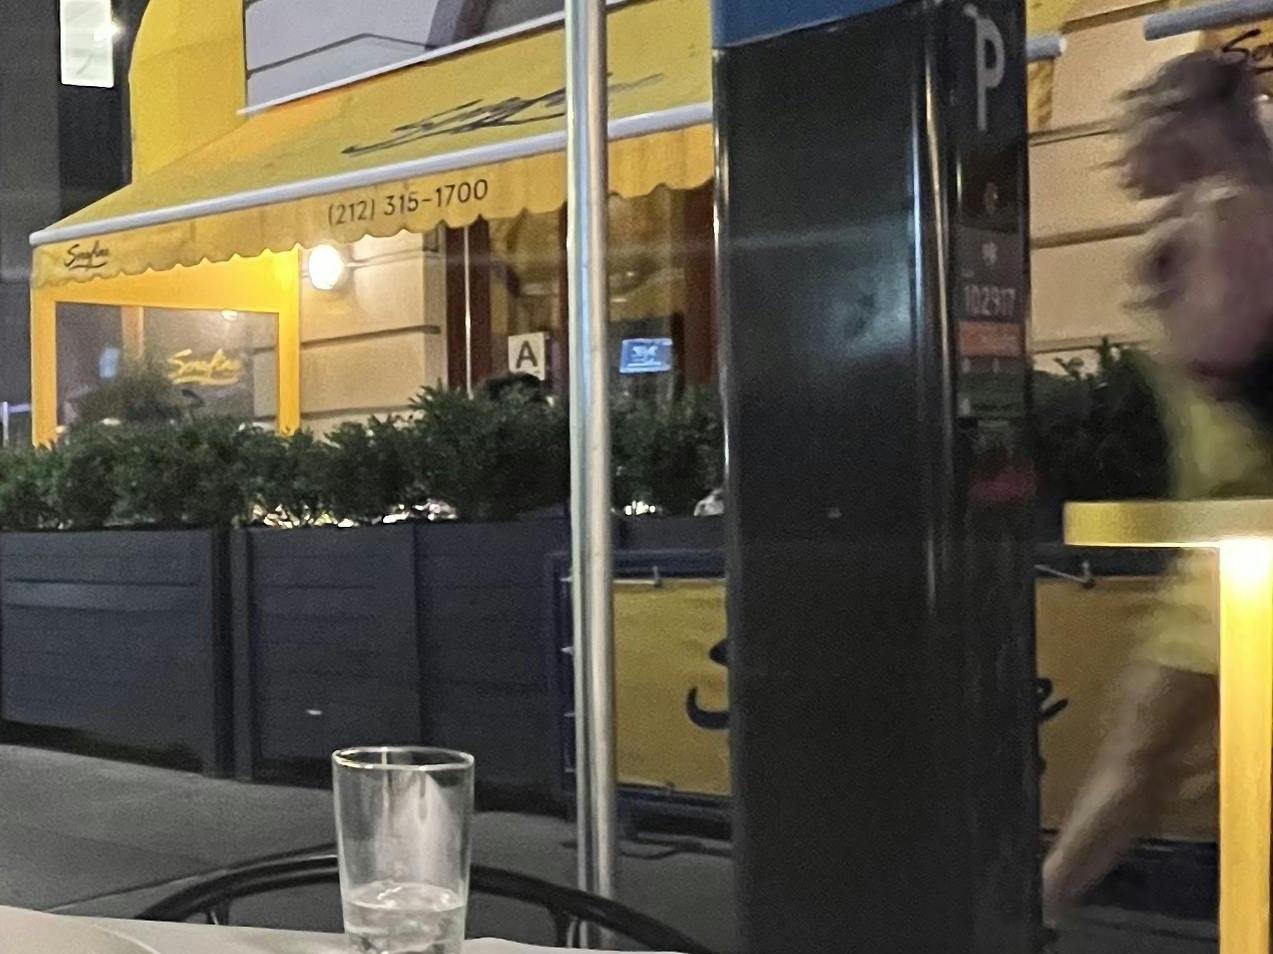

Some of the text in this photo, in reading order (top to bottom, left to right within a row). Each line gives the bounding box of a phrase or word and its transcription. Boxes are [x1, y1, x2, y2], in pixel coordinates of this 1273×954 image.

[328, 179, 488, 226] (212) 315-1700
[515, 340, 539, 369] A
